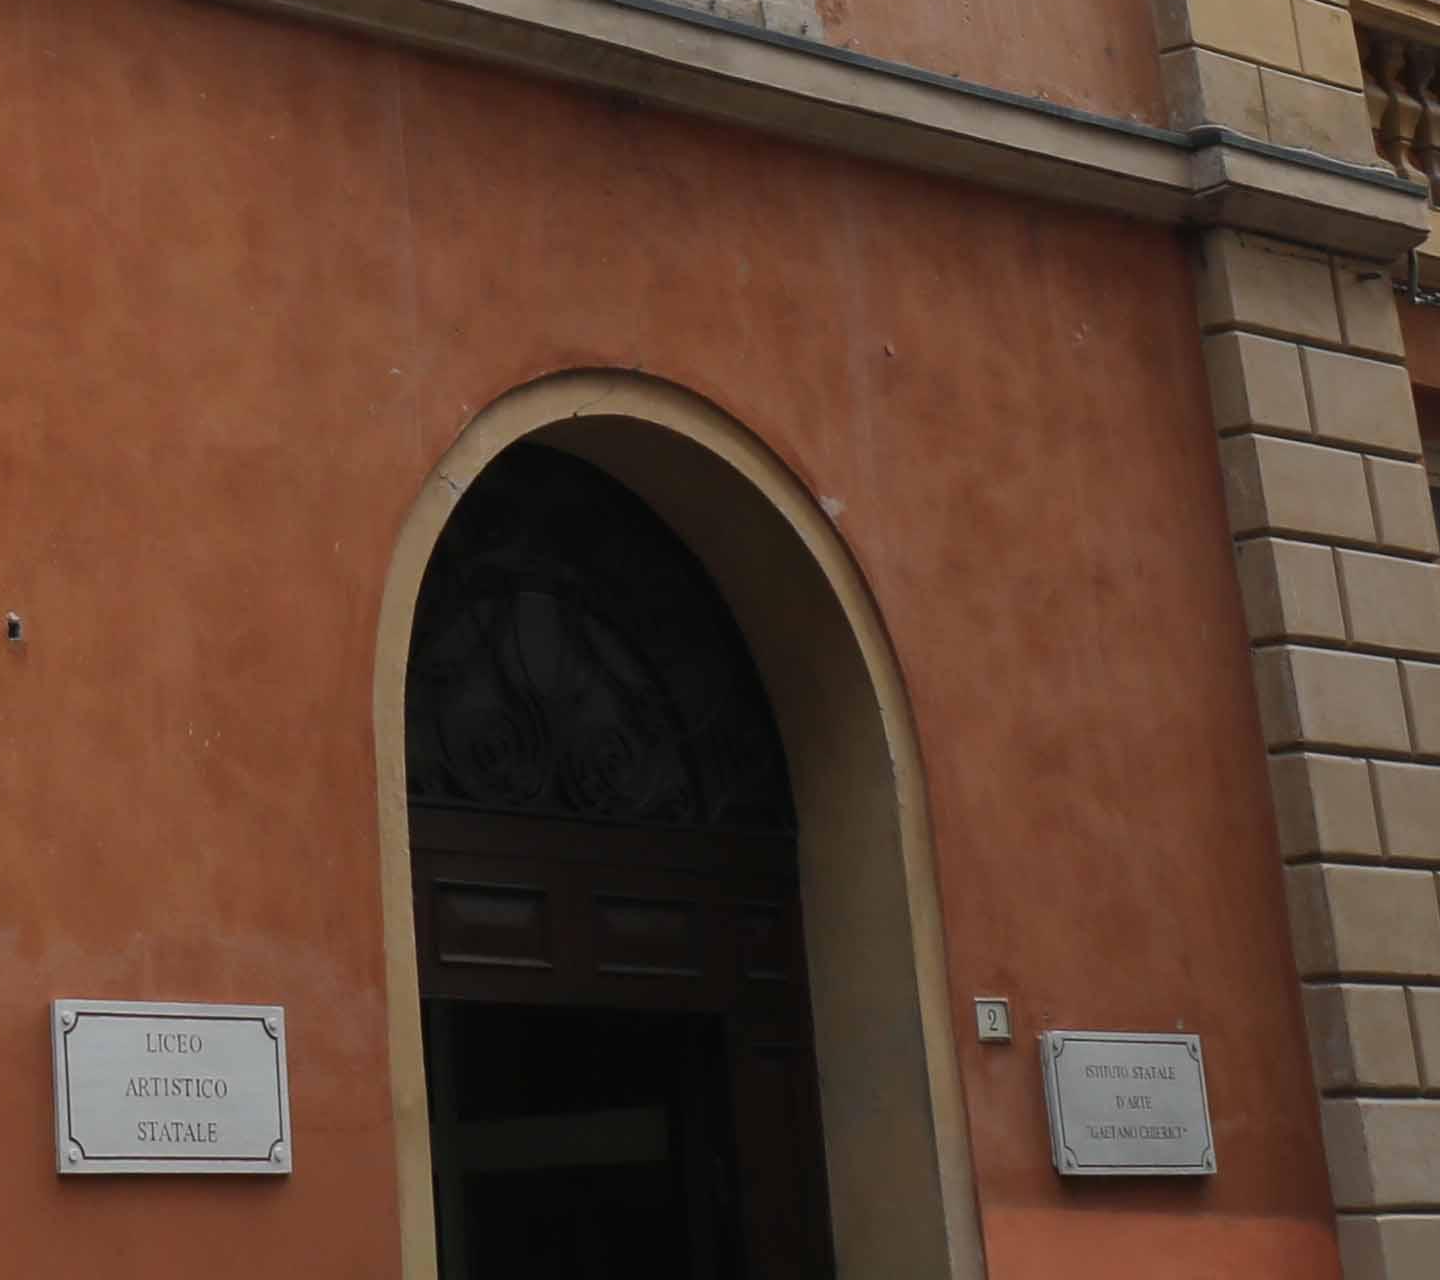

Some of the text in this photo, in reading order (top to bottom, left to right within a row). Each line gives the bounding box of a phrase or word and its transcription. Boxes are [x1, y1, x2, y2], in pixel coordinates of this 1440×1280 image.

[987, 1008, 999, 1032] 2
[145, 1032, 203, 1054] LICEO
[1085, 1065, 1176, 1081] ISTITUTO STATALE
[125, 1077, 228, 1099] ARTISTICO
[136, 1121, 219, 1143] STATALE
